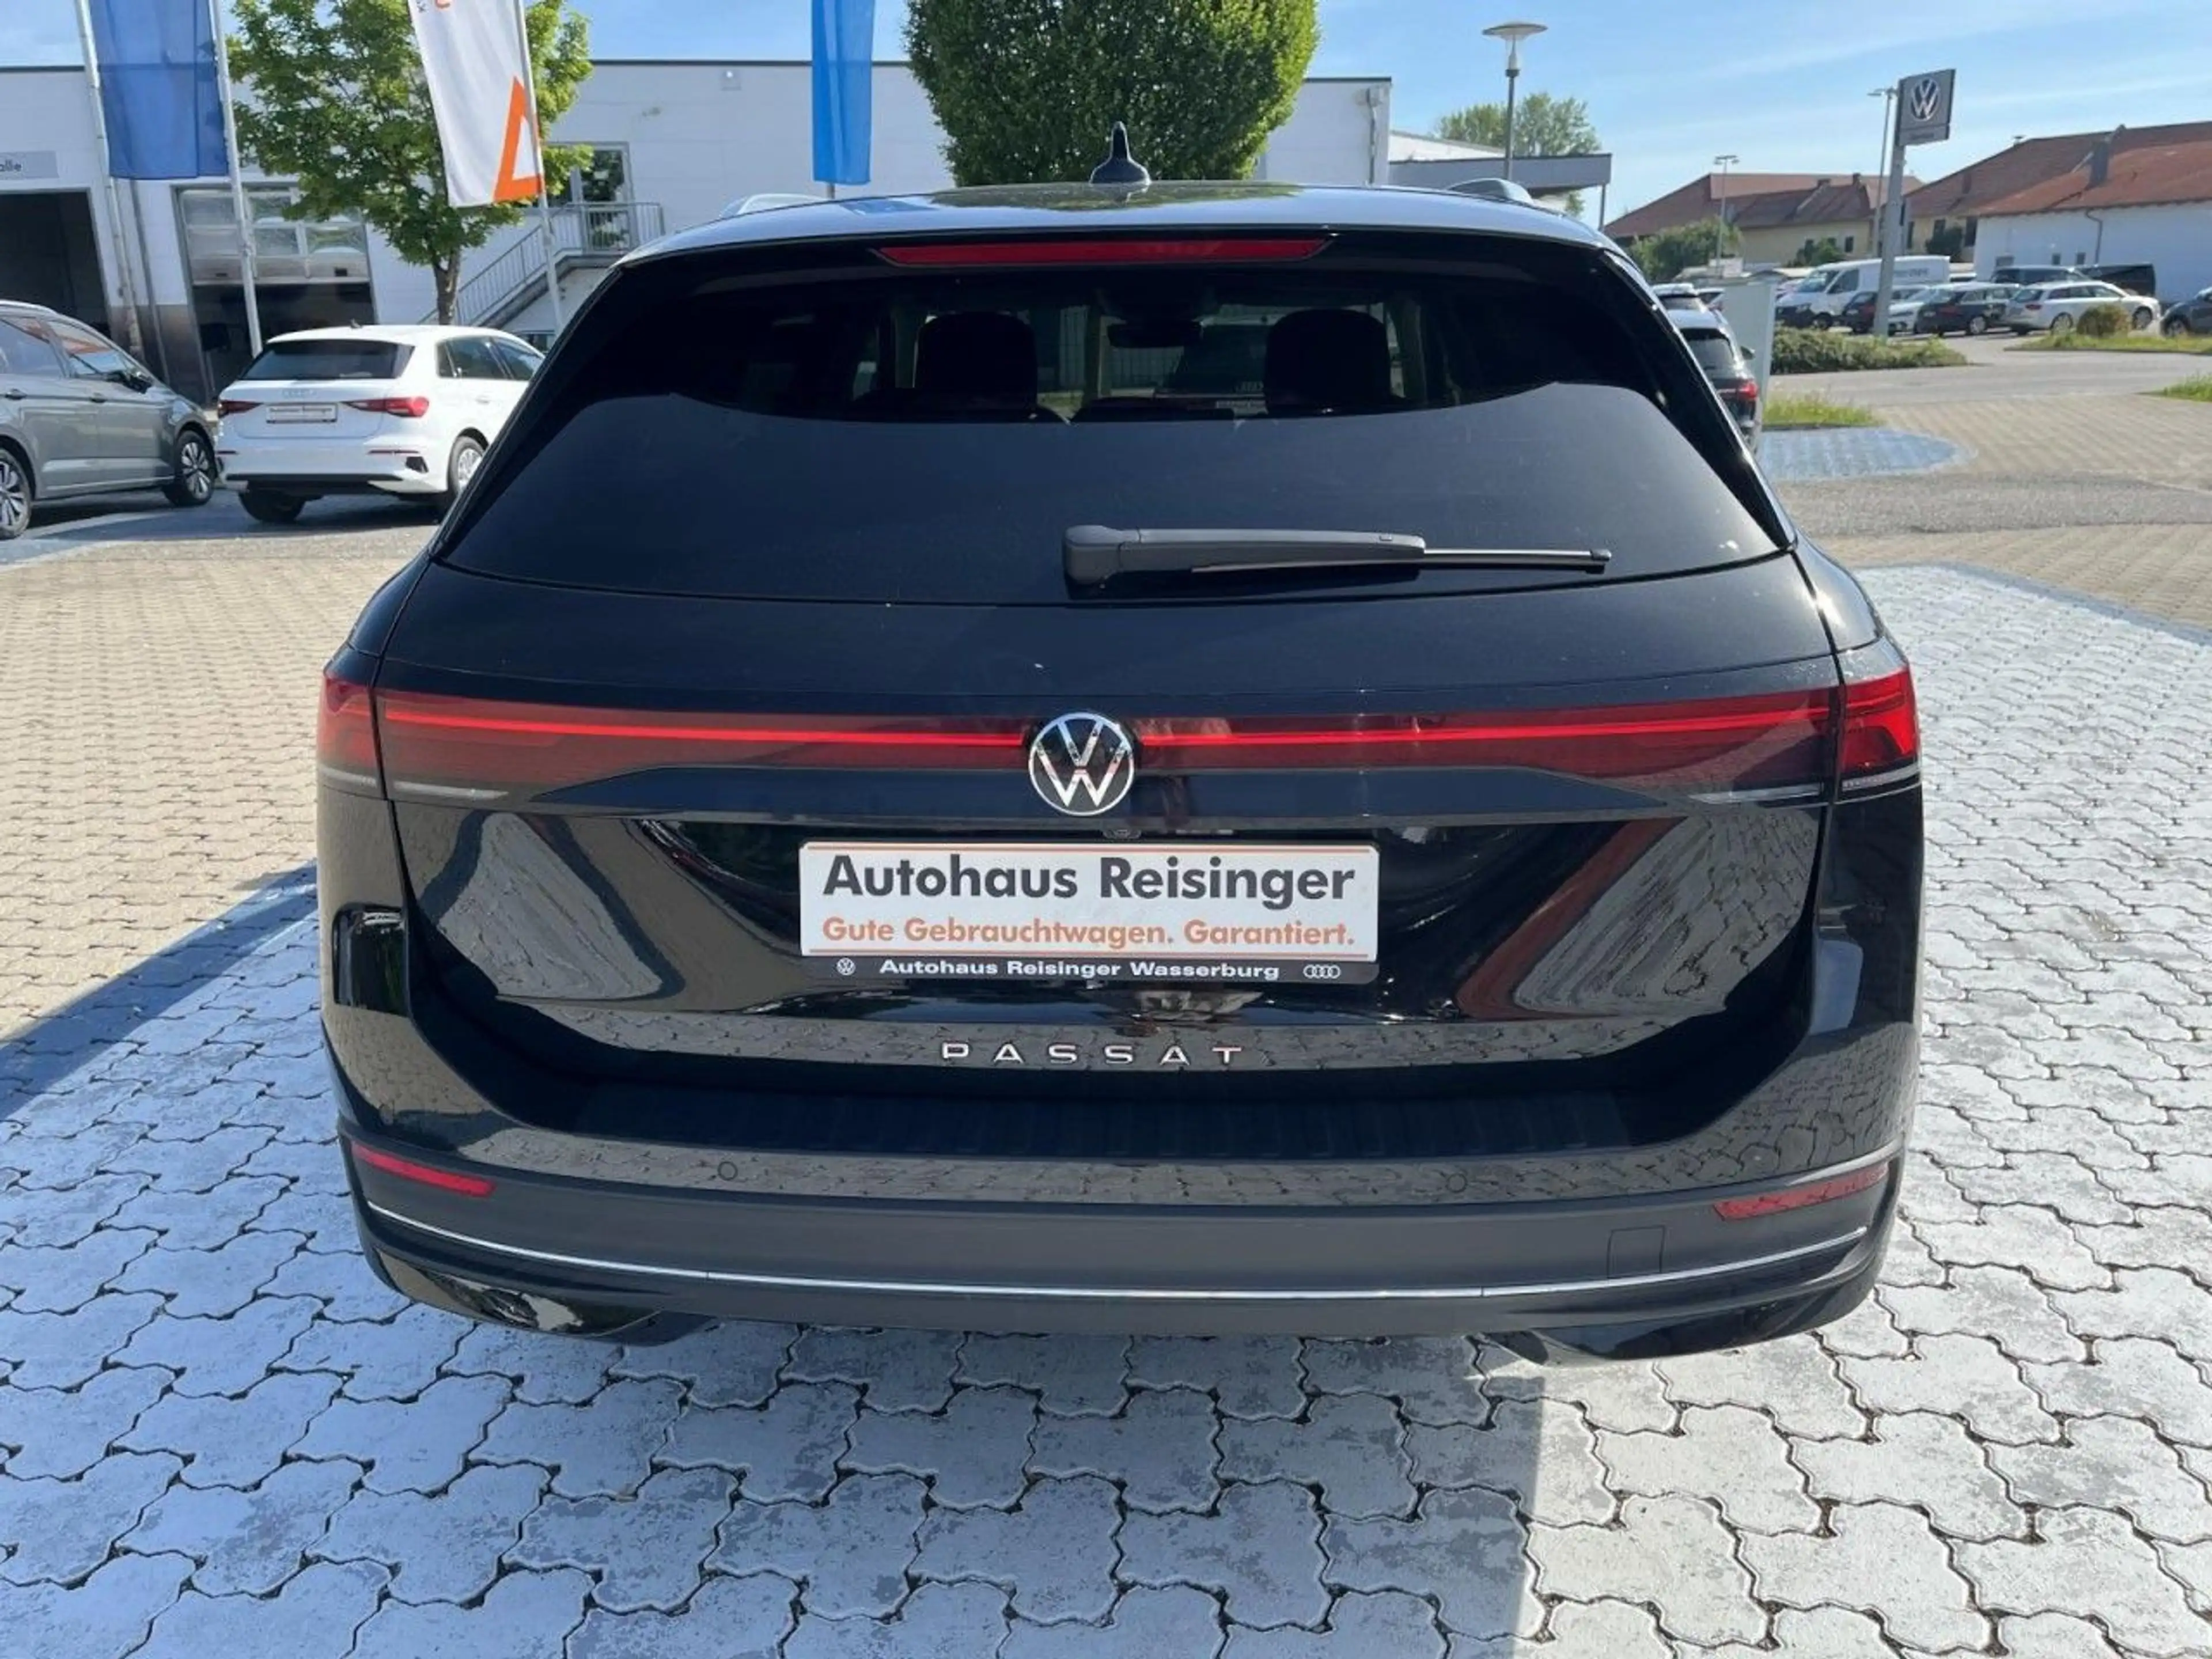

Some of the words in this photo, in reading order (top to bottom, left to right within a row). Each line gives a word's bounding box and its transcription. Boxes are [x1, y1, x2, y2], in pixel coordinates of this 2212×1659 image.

[823, 854, 1077, 898] Autohaus
[1100, 856, 1355, 910] Reisinger
[823, 917, 894, 941] Gute
[904, 917, 1173, 949] Gebrauchtwagen.
[1184, 919, 1354, 945] Garantiert.
[880, 959, 998, 974] Autohaus
[1007, 960, 1121, 978] Reisinger
[1130, 961, 1279, 979] Wasserburg
[942, 1043, 1242, 1065] PASSAT
